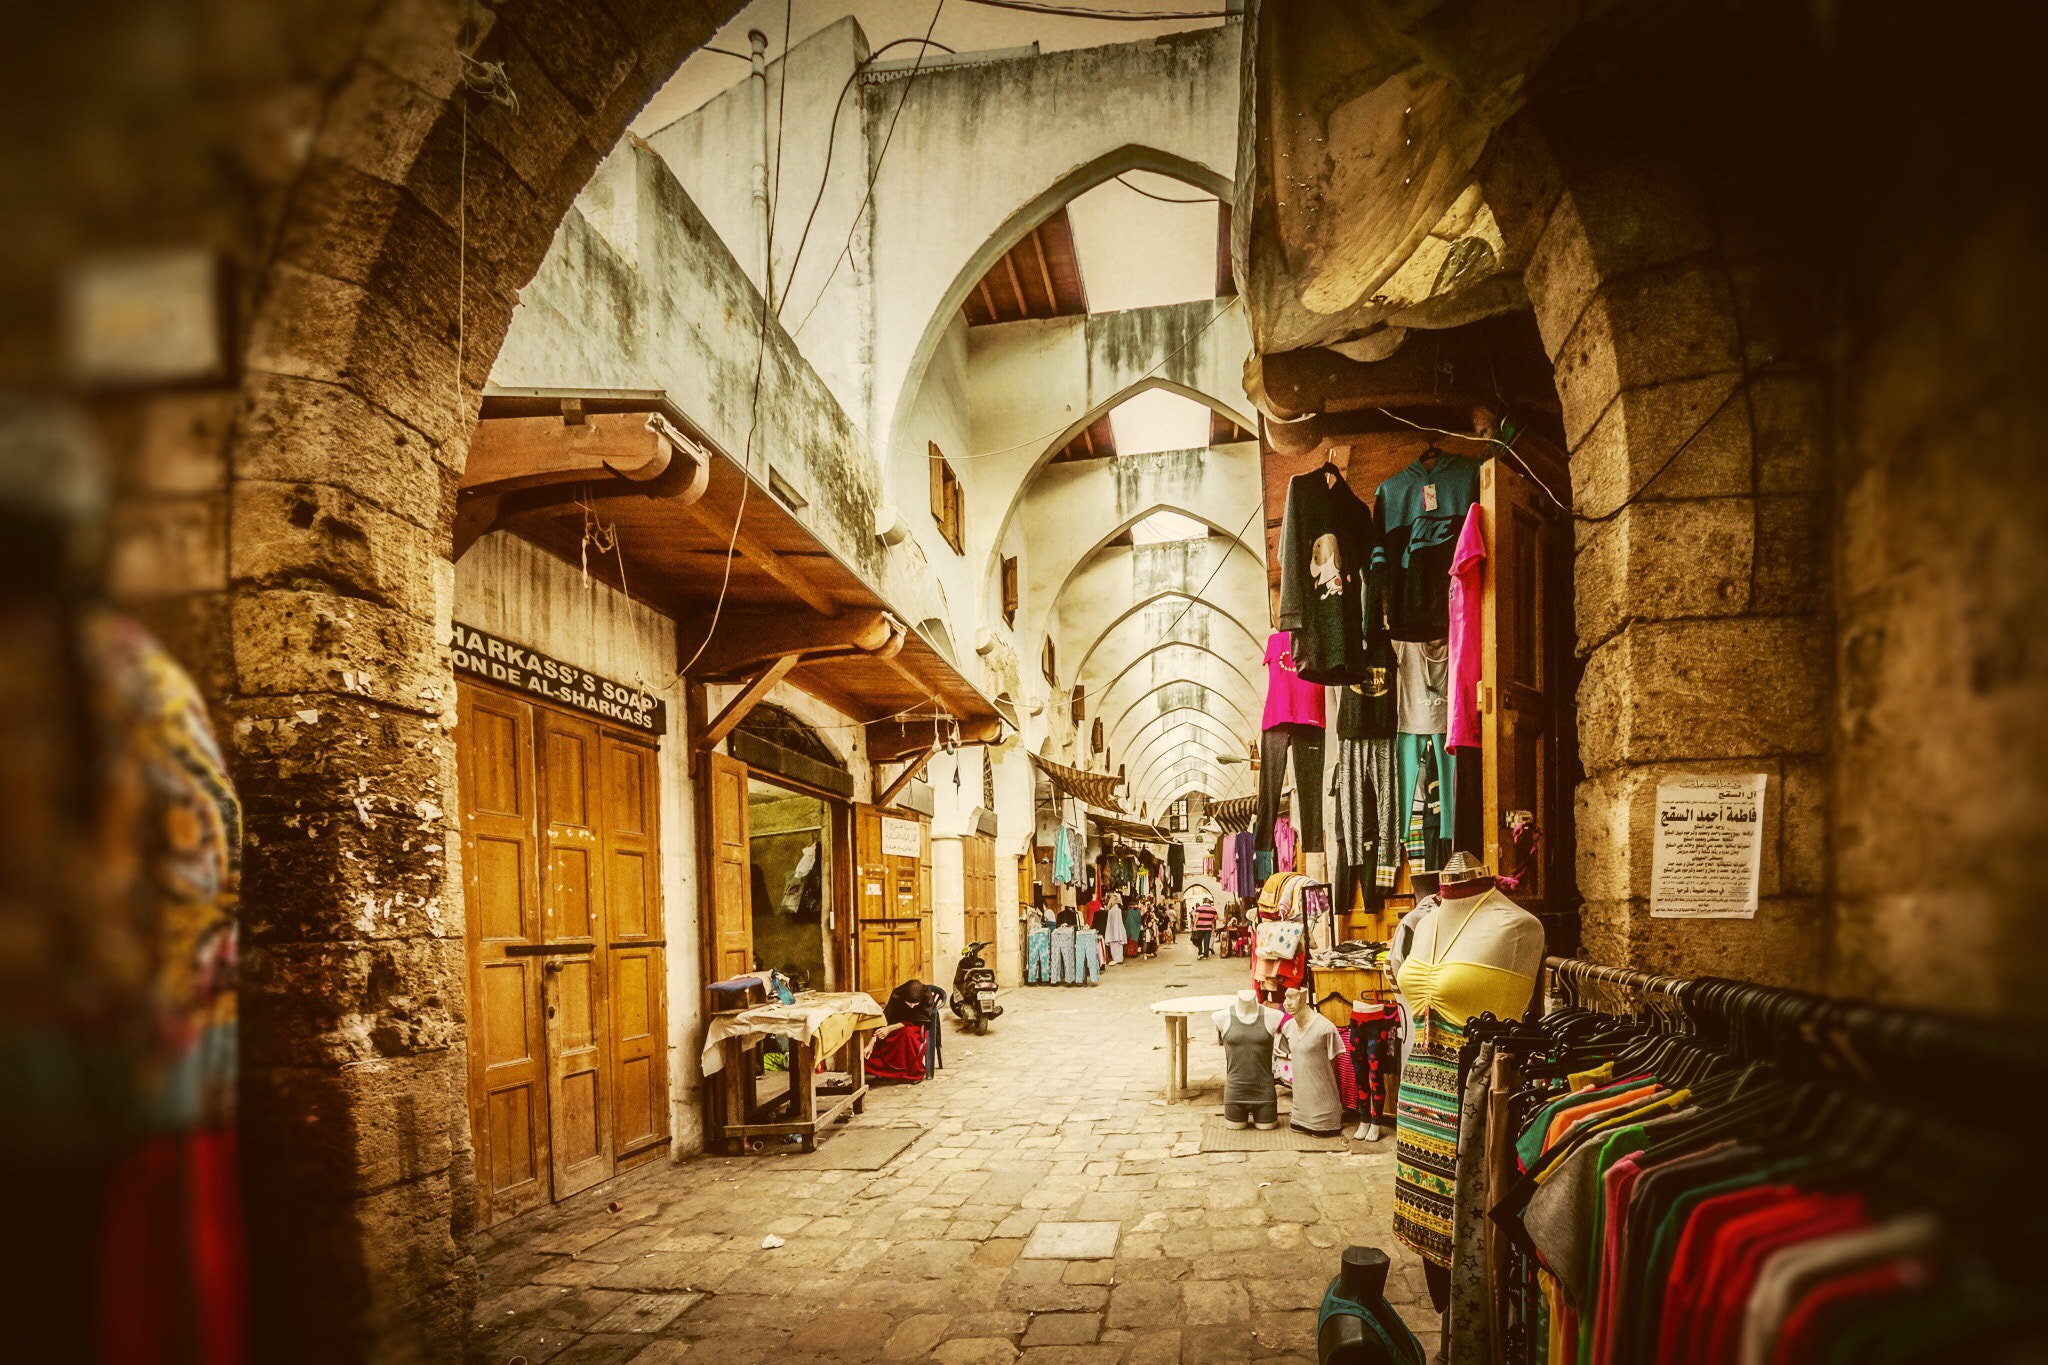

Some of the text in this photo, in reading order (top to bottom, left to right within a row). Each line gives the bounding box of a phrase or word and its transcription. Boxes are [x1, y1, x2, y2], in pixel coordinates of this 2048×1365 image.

[491, 662, 521, 686] DE
[527, 676, 653, 729] AL-SHARKASS
[602, 682, 653, 713] SOAP
[1696, 804, 1723, 822] أحمد
[1726, 806, 1757, 823] فاطمة
